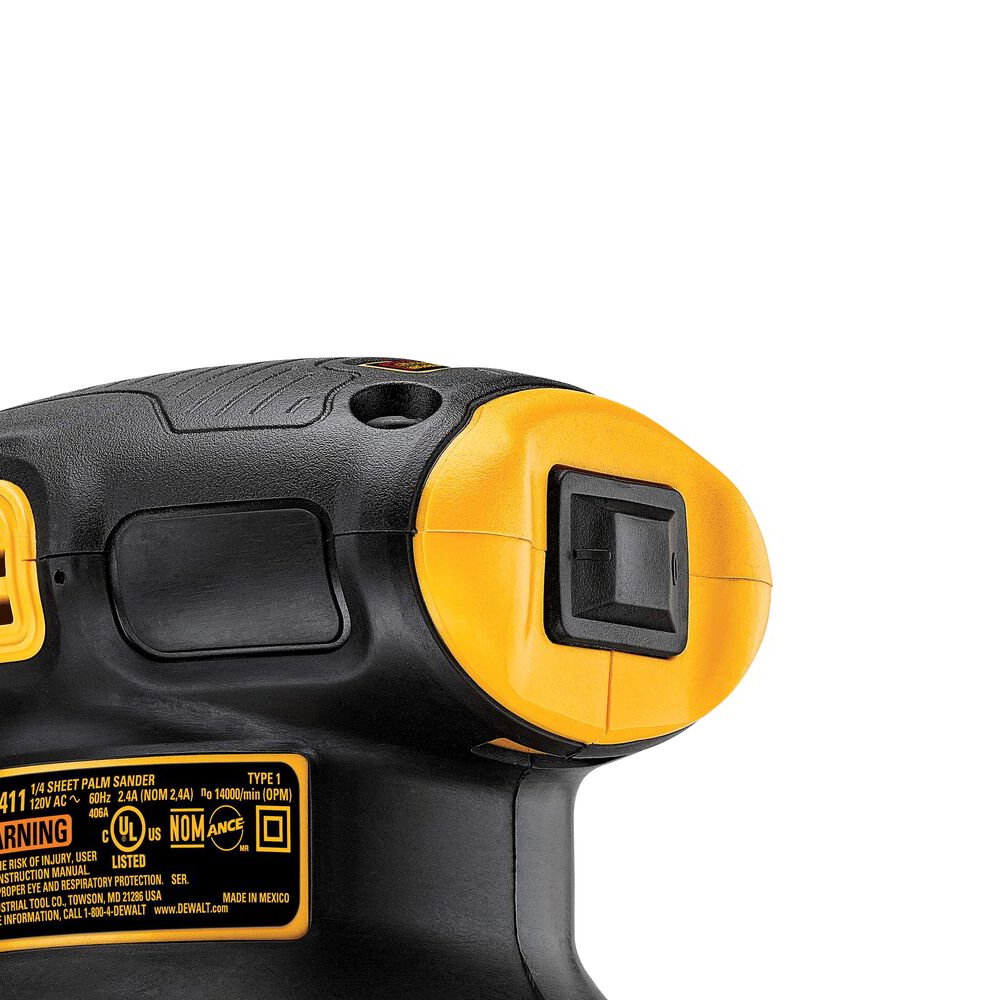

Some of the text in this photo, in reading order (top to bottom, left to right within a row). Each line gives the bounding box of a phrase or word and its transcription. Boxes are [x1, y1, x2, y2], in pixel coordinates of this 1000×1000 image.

[31, 774, 155, 796] 1/4 SHEET PALM SANDER
[248, 772, 281, 785] TYPE 1
[30, 794, 67, 810] 120V AC
[89, 787, 193, 804] 60Hz 2.4A (NOM 2,4A)
[214, 787, 260, 802] 14000/min
[262, 787, 292, 803] (OPM)
[88, 807, 109, 818] 406A
[148, 827, 161, 841] US
[170, 814, 204, 842] NOM
[207, 817, 245, 838] ANCE
[102, 829, 109, 843] C
[9, 857, 27, 870] RISK
[29, 856, 40, 867] OF
[41, 852, 74, 866] INJURY,
[75, 850, 97, 862] USER
[112, 853, 146, 869] LISTED
[27, 882, 41, 894] EYE
[43, 880, 59, 893] AND
[61, 876, 112, 891] RESPIRATORY
[114, 873, 164, 889] PROTECTION.
[171, 873, 189, 885] SER.
[30, 897, 50, 909] TOOL
[51, 895, 67, 908] CO.,
[68, 892, 106, 905] TOWSON,
[107, 891, 120, 903] MD
[122, 891, 144, 903] 21286
[145, 889, 162, 901] USA
[222, 892, 290, 904] MADE IN MEXICO
[4, 909, 61, 925] INFORMATION,
[63, 907, 82, 920] CALL
[84, 904, 147, 918] 1-800-4-DEWALT
[154, 902, 229, 915] www.DEWALT.com
